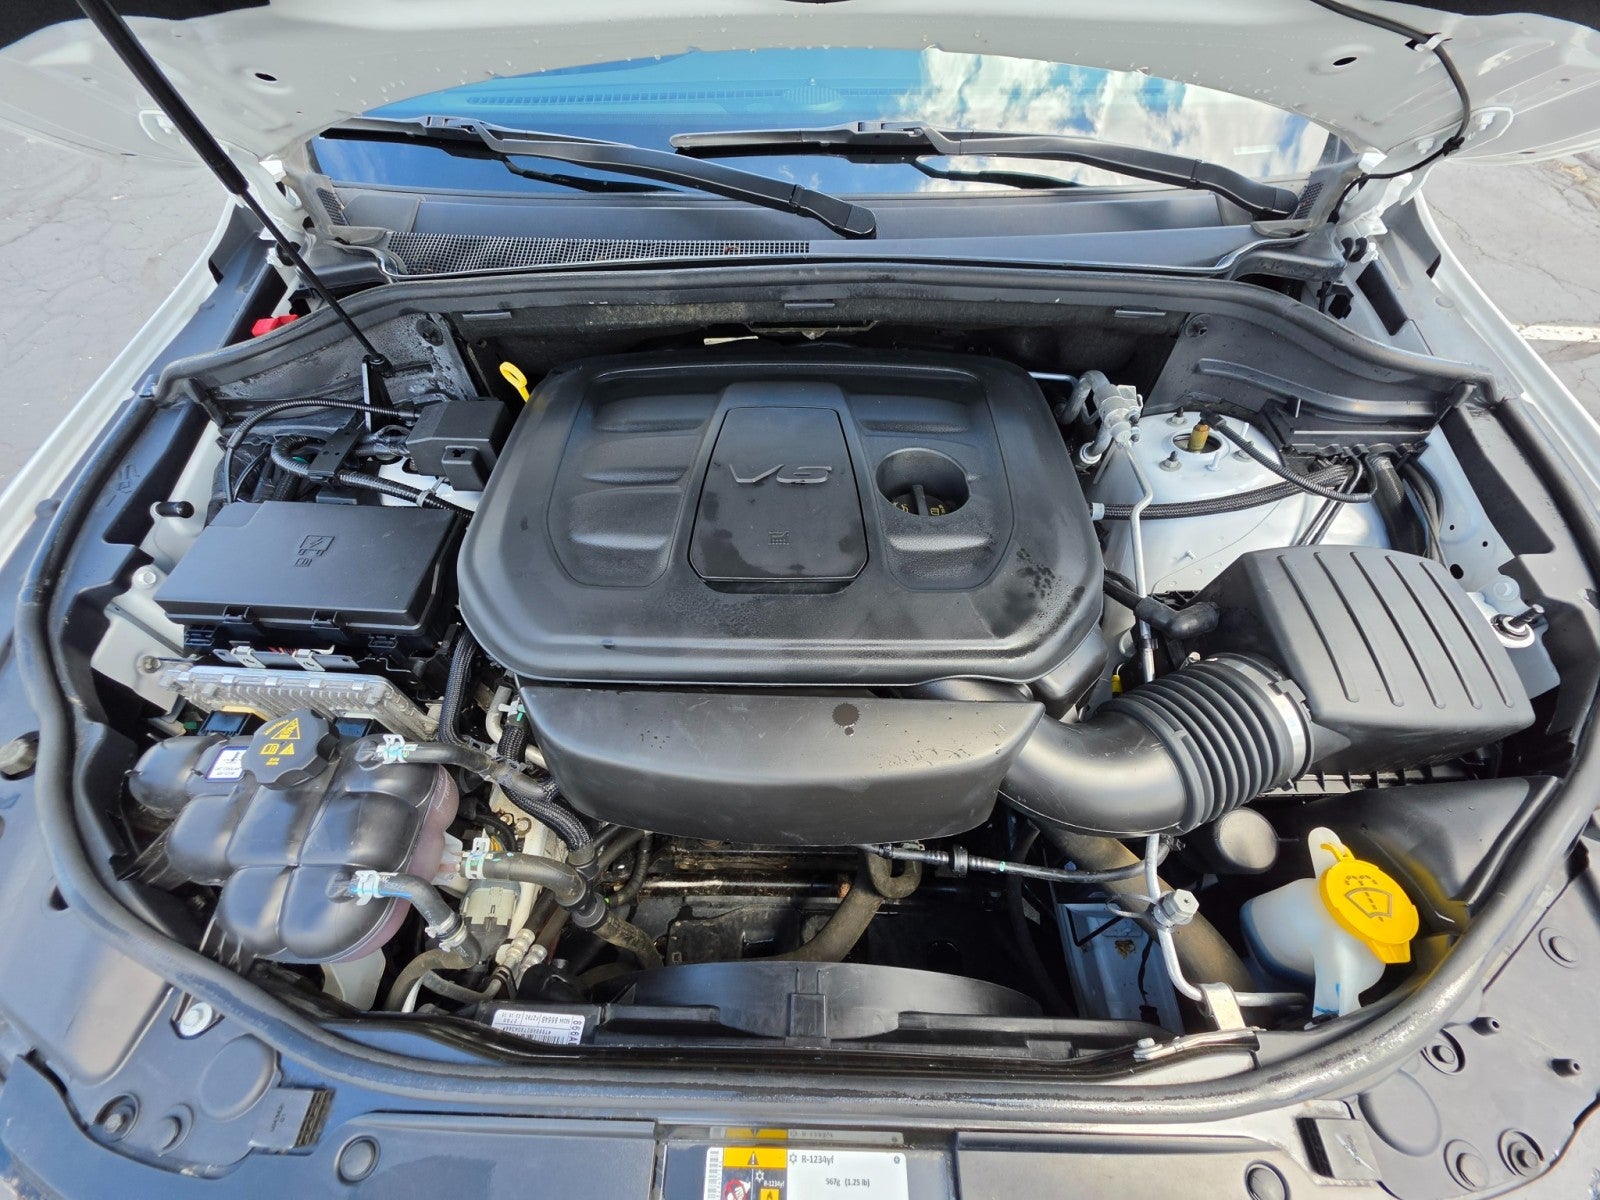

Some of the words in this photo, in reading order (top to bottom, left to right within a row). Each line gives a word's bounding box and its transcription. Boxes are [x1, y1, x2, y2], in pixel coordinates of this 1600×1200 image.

[728, 463, 833, 485] V6
[801, 1154, 834, 1166] R-1234yf
[844, 1178, 861, 1188] (1.25
